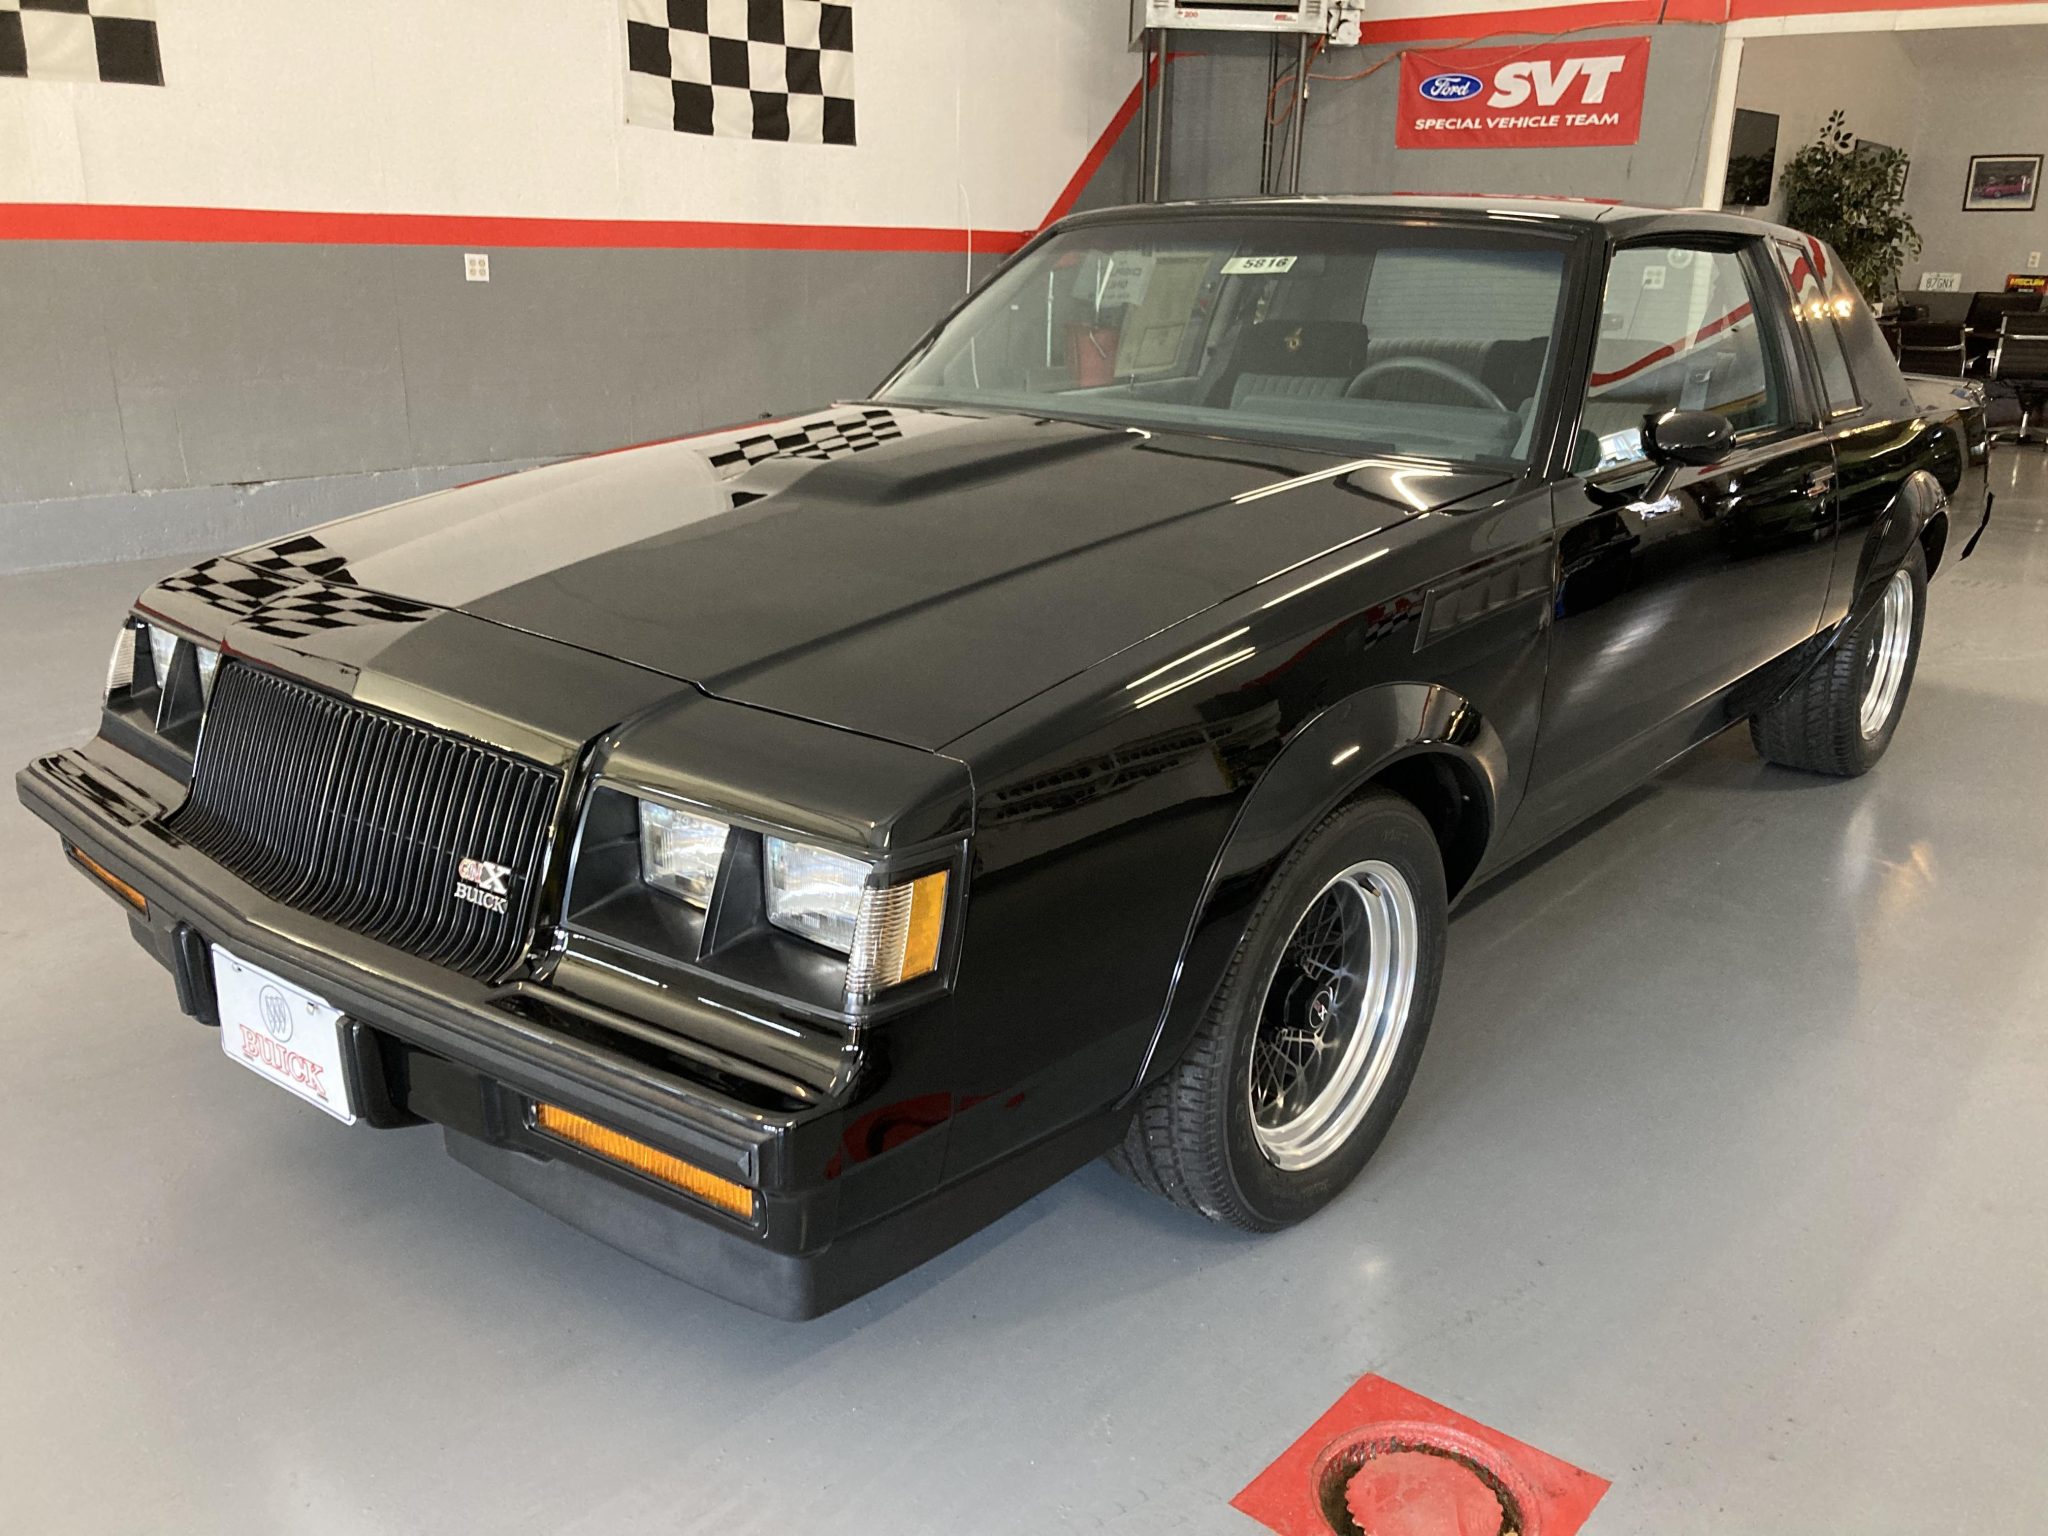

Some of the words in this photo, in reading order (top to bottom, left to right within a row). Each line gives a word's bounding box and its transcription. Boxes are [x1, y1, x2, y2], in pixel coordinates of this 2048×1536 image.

[1430, 77, 1470, 98] Ford
[1486, 55, 1626, 109] SVT
[1414, 115, 1482, 131] SPECIAL
[1486, 114, 1560, 129] VEHICLE
[1564, 113, 1619, 126] TEAM
[1242, 257, 1289, 269] 5816
[1926, 277, 1955, 289] 87GNX
[458, 858, 512, 895] GNX
[453, 881, 508, 914] BUICK
[239, 1023, 328, 1098] BUICK
